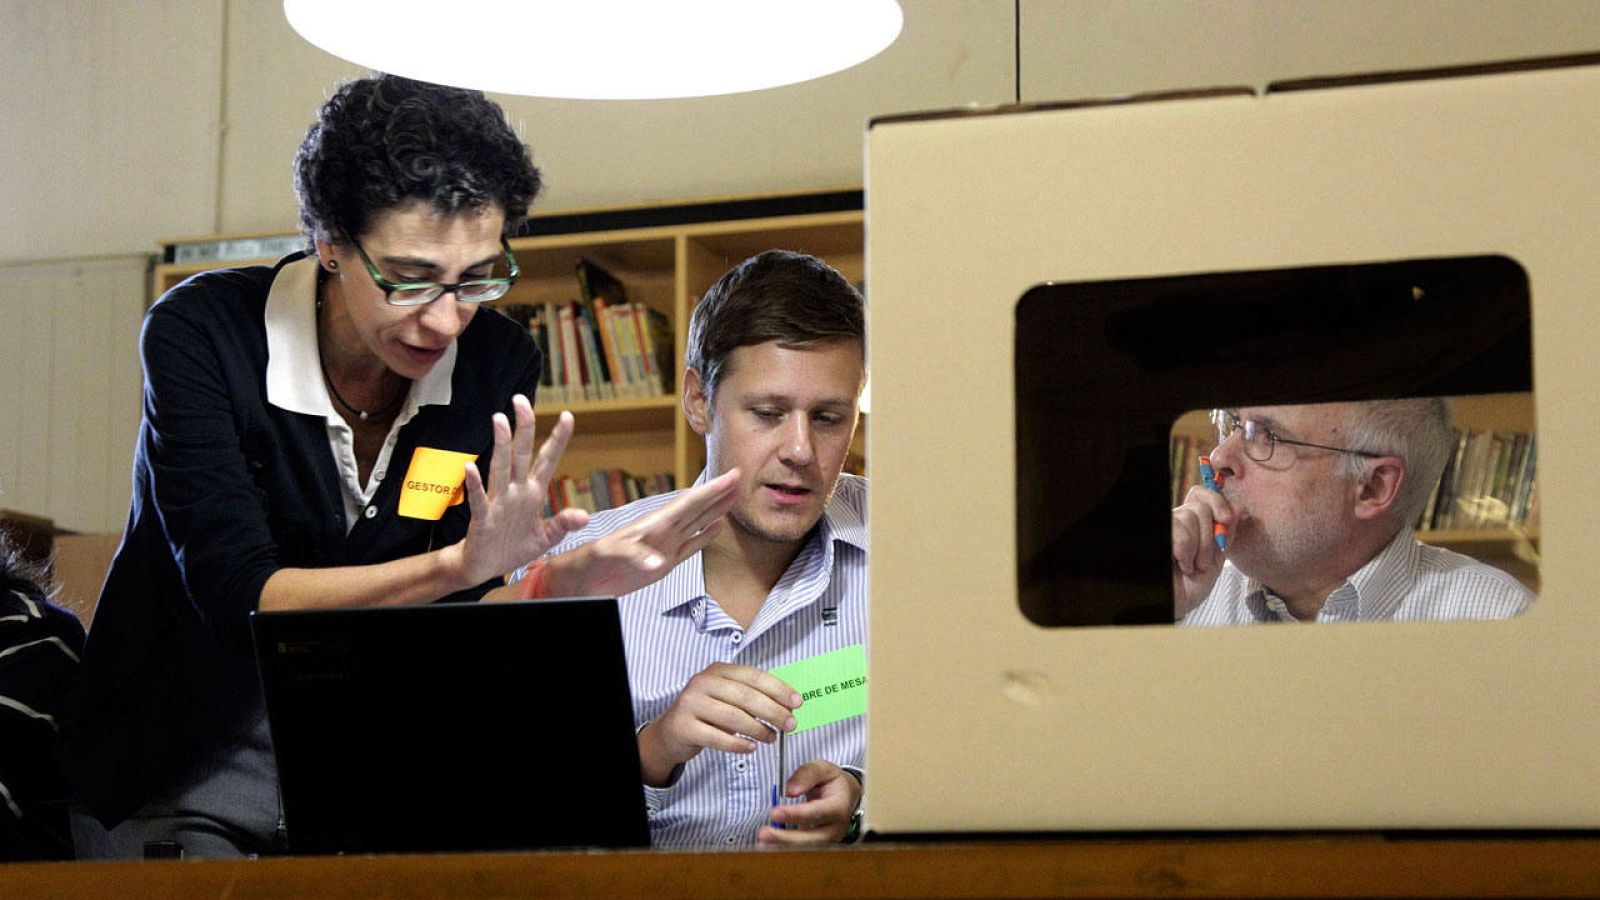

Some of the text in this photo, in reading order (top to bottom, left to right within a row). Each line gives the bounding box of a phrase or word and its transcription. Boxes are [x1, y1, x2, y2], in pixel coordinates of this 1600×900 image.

[407, 480, 451, 495] GESTOR
[801, 688, 823, 701] BRE
[824, 684, 839, 695] DE
